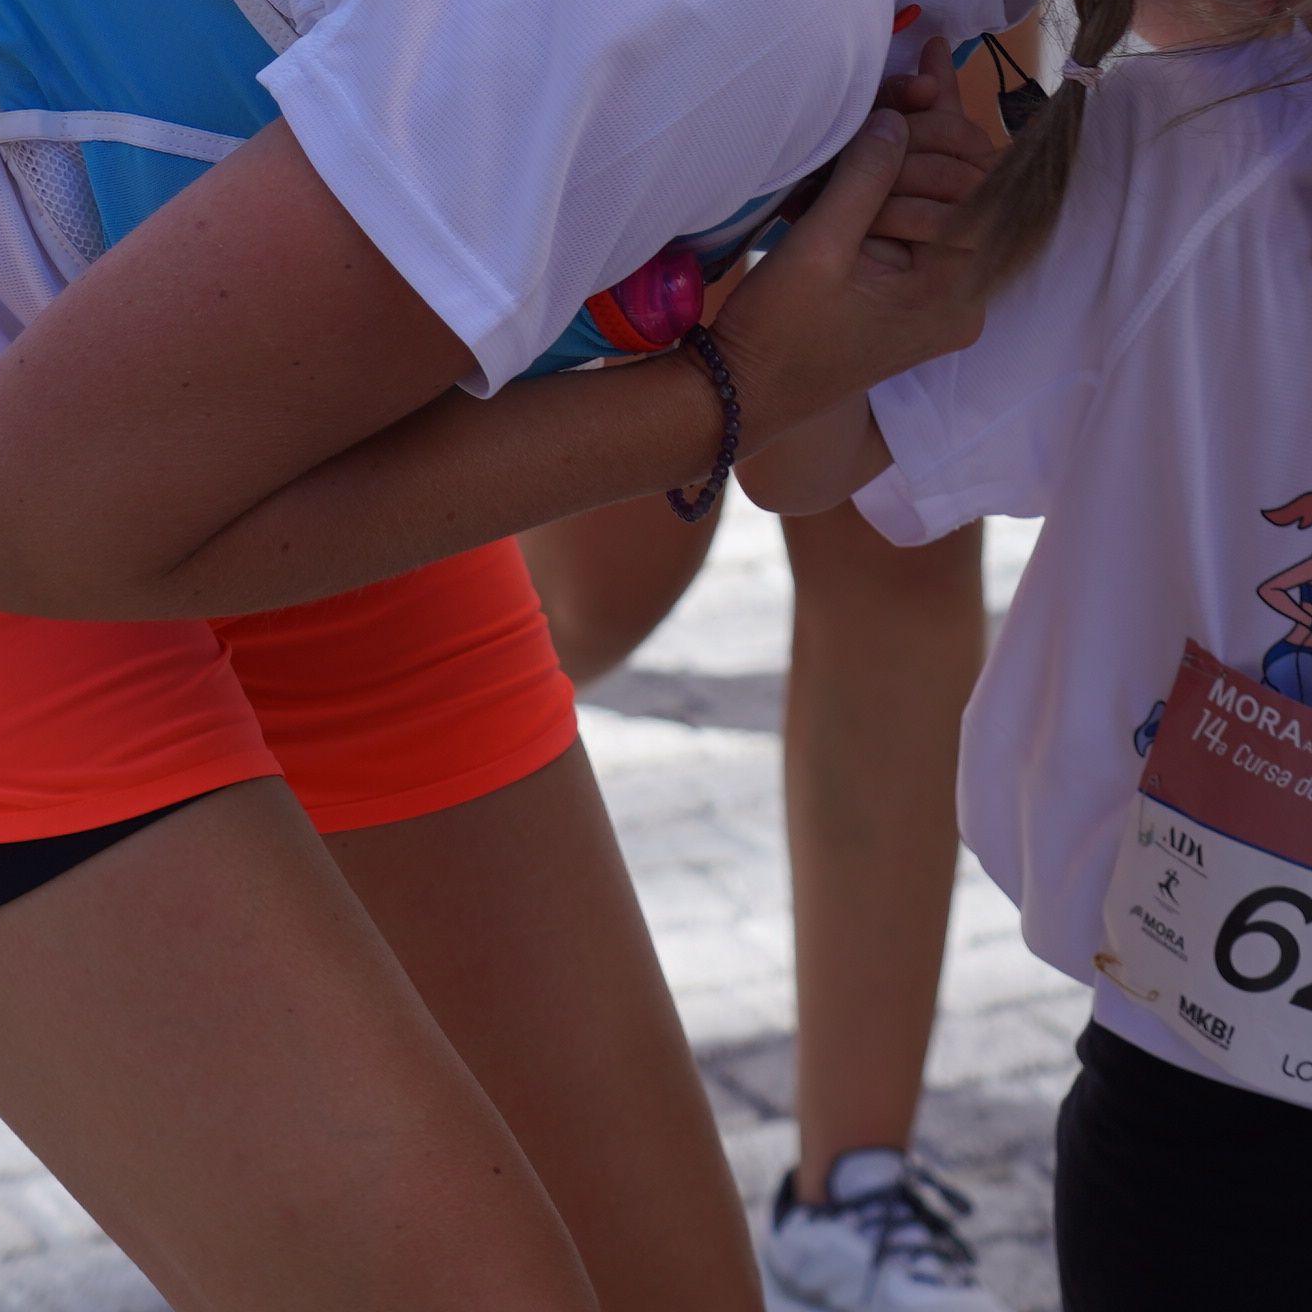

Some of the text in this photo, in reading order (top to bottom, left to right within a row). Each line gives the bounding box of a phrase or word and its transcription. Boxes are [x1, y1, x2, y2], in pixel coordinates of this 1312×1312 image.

[1208, 676, 1303, 748] MORA
[1232, 744, 1292, 788] Cursa
[1142, 911, 1185, 950] MORA
